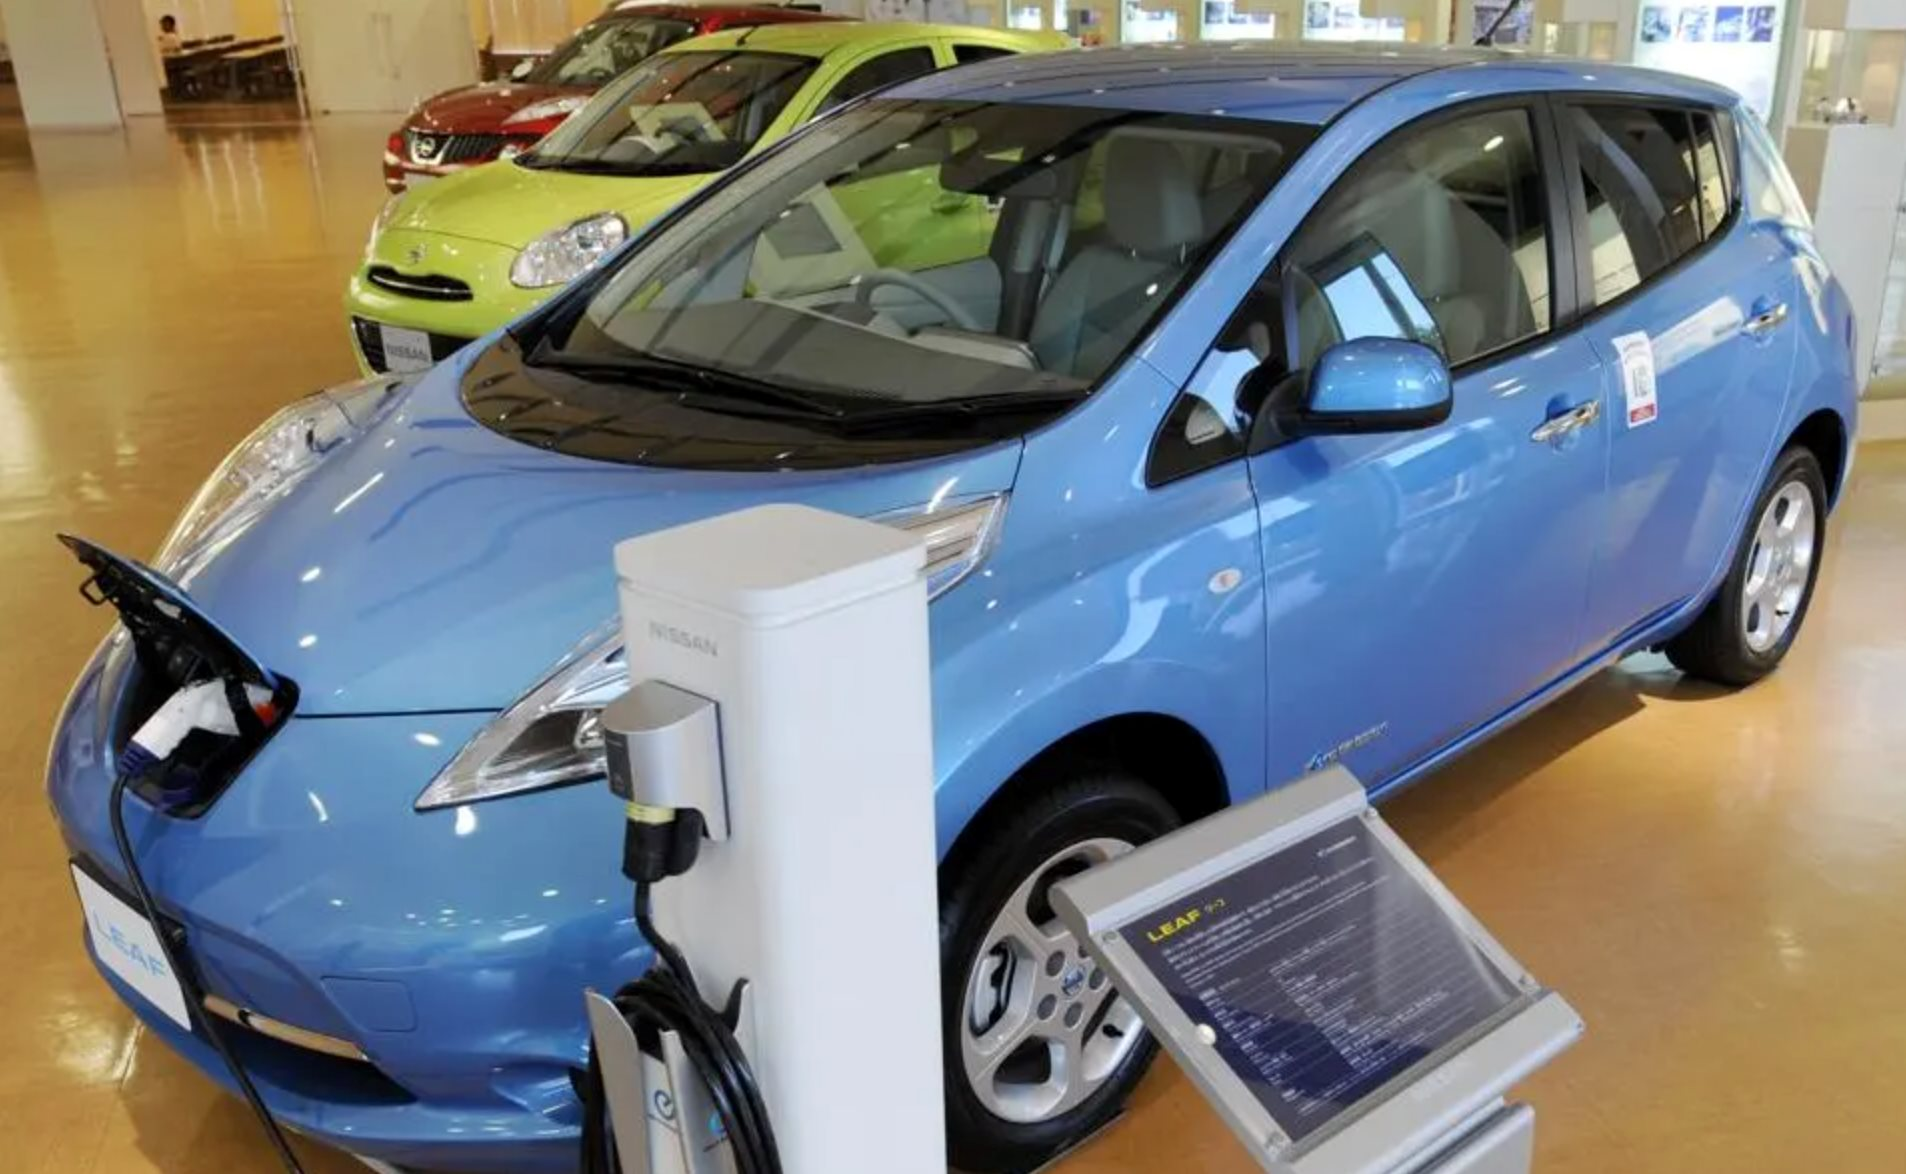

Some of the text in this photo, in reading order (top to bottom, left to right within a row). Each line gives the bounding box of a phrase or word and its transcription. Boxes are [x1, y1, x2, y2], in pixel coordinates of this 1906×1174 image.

[649, 620, 719, 657] NISSAN
[93, 910, 165, 977] LEAF
[1146, 908, 1200, 942] LEAF
